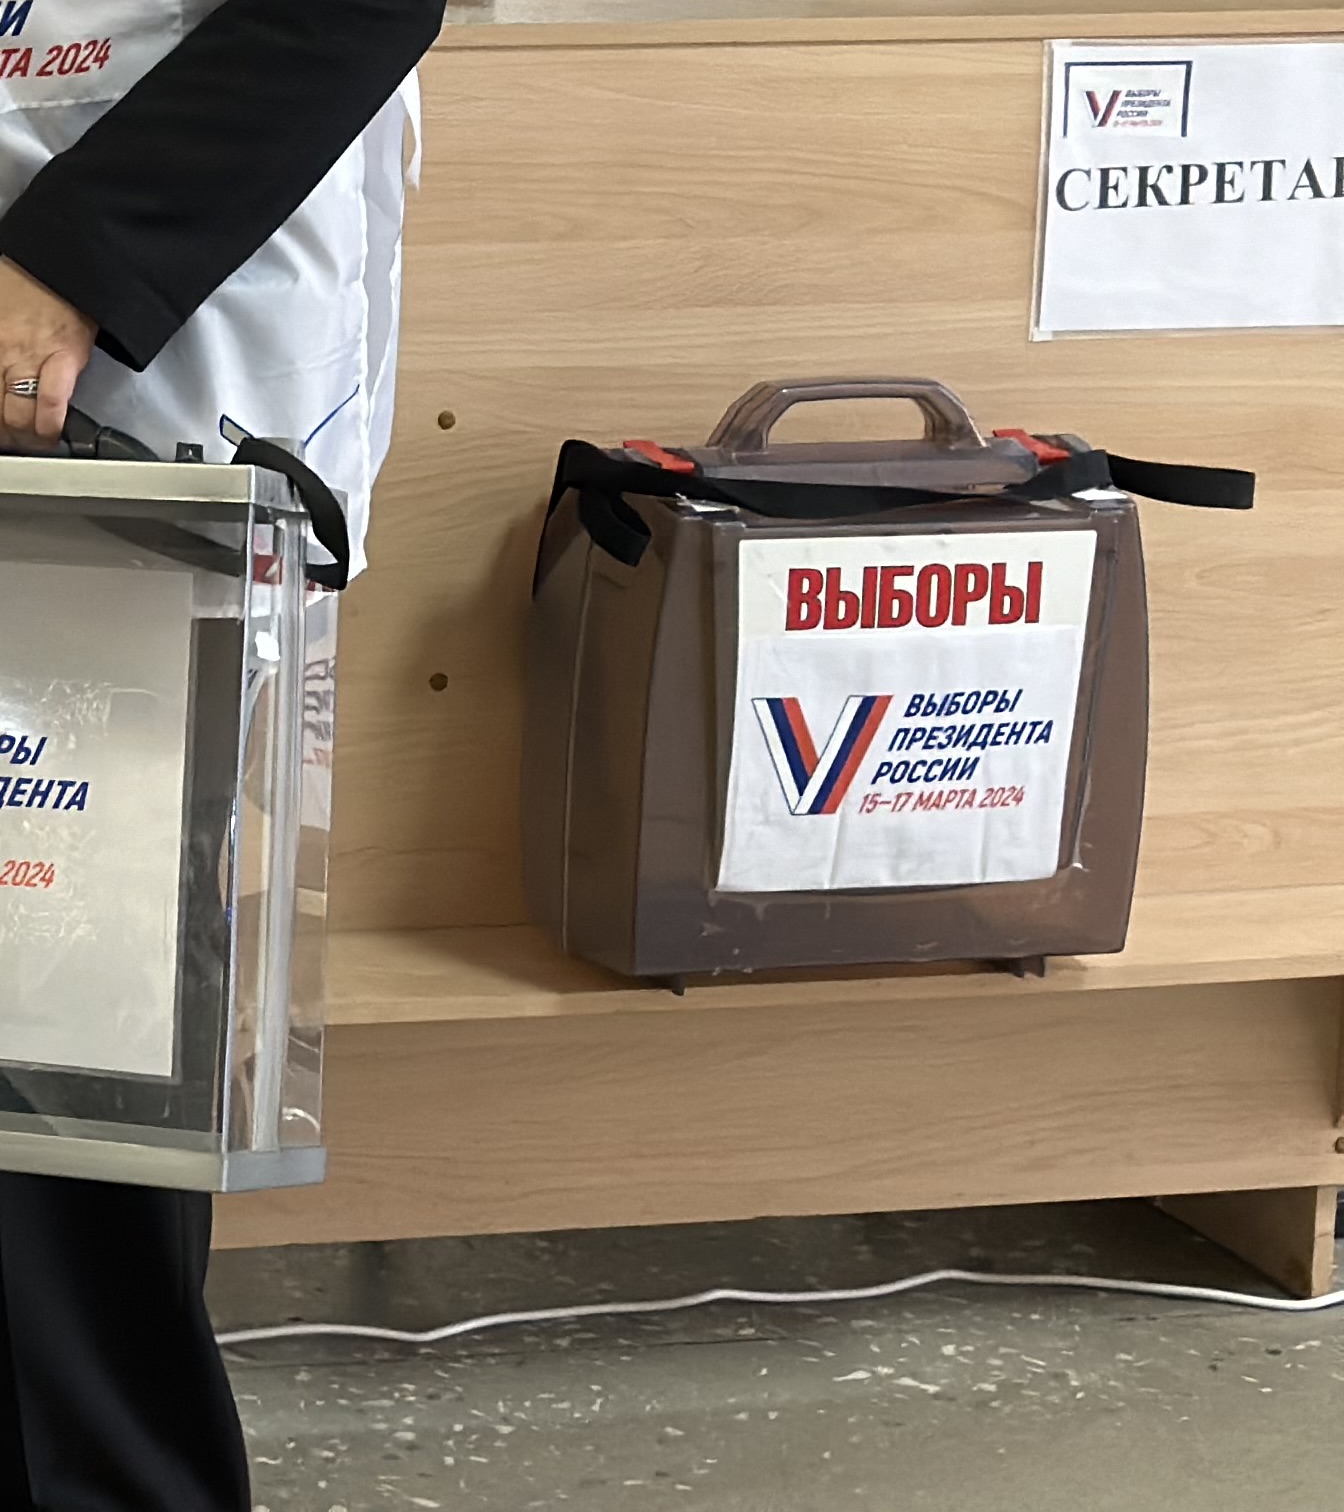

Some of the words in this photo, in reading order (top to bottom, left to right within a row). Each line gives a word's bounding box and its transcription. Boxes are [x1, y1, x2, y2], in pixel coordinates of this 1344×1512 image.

[35, 37, 111, 79] 2024
[785, 561, 1044, 632] ВЫБОРЫ
[903, 688, 1024, 718] ВЫБОРЫ
[887, 719, 1055, 753] ПРЕЗИДЕНТА
[870, 757, 980, 786] РОССИИ
[911, 787, 976, 813] МАРТА
[978, 785, 1026, 810] 2024
